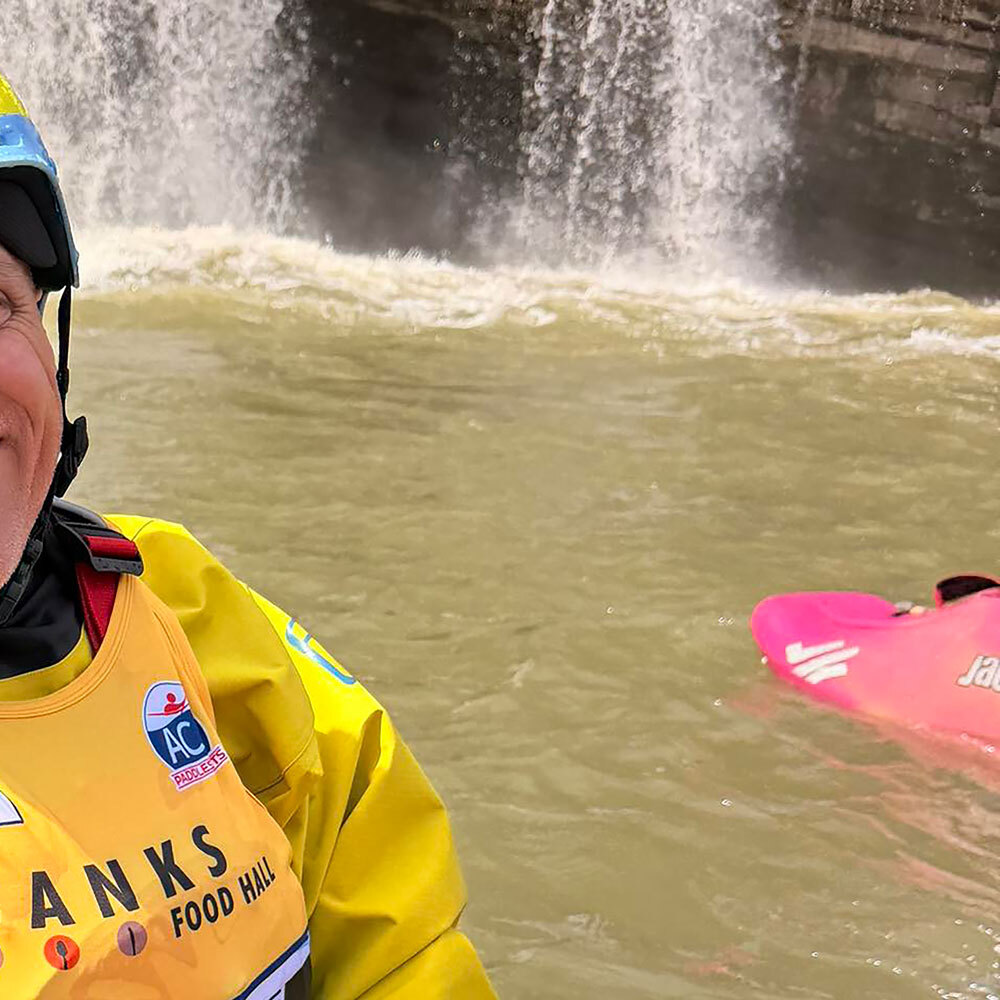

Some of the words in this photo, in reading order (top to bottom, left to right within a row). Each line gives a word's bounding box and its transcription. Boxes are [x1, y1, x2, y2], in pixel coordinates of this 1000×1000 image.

[162, 720, 206, 764] AC
[170, 886, 234, 938] FOOD
[238, 856, 276, 904] HALL
